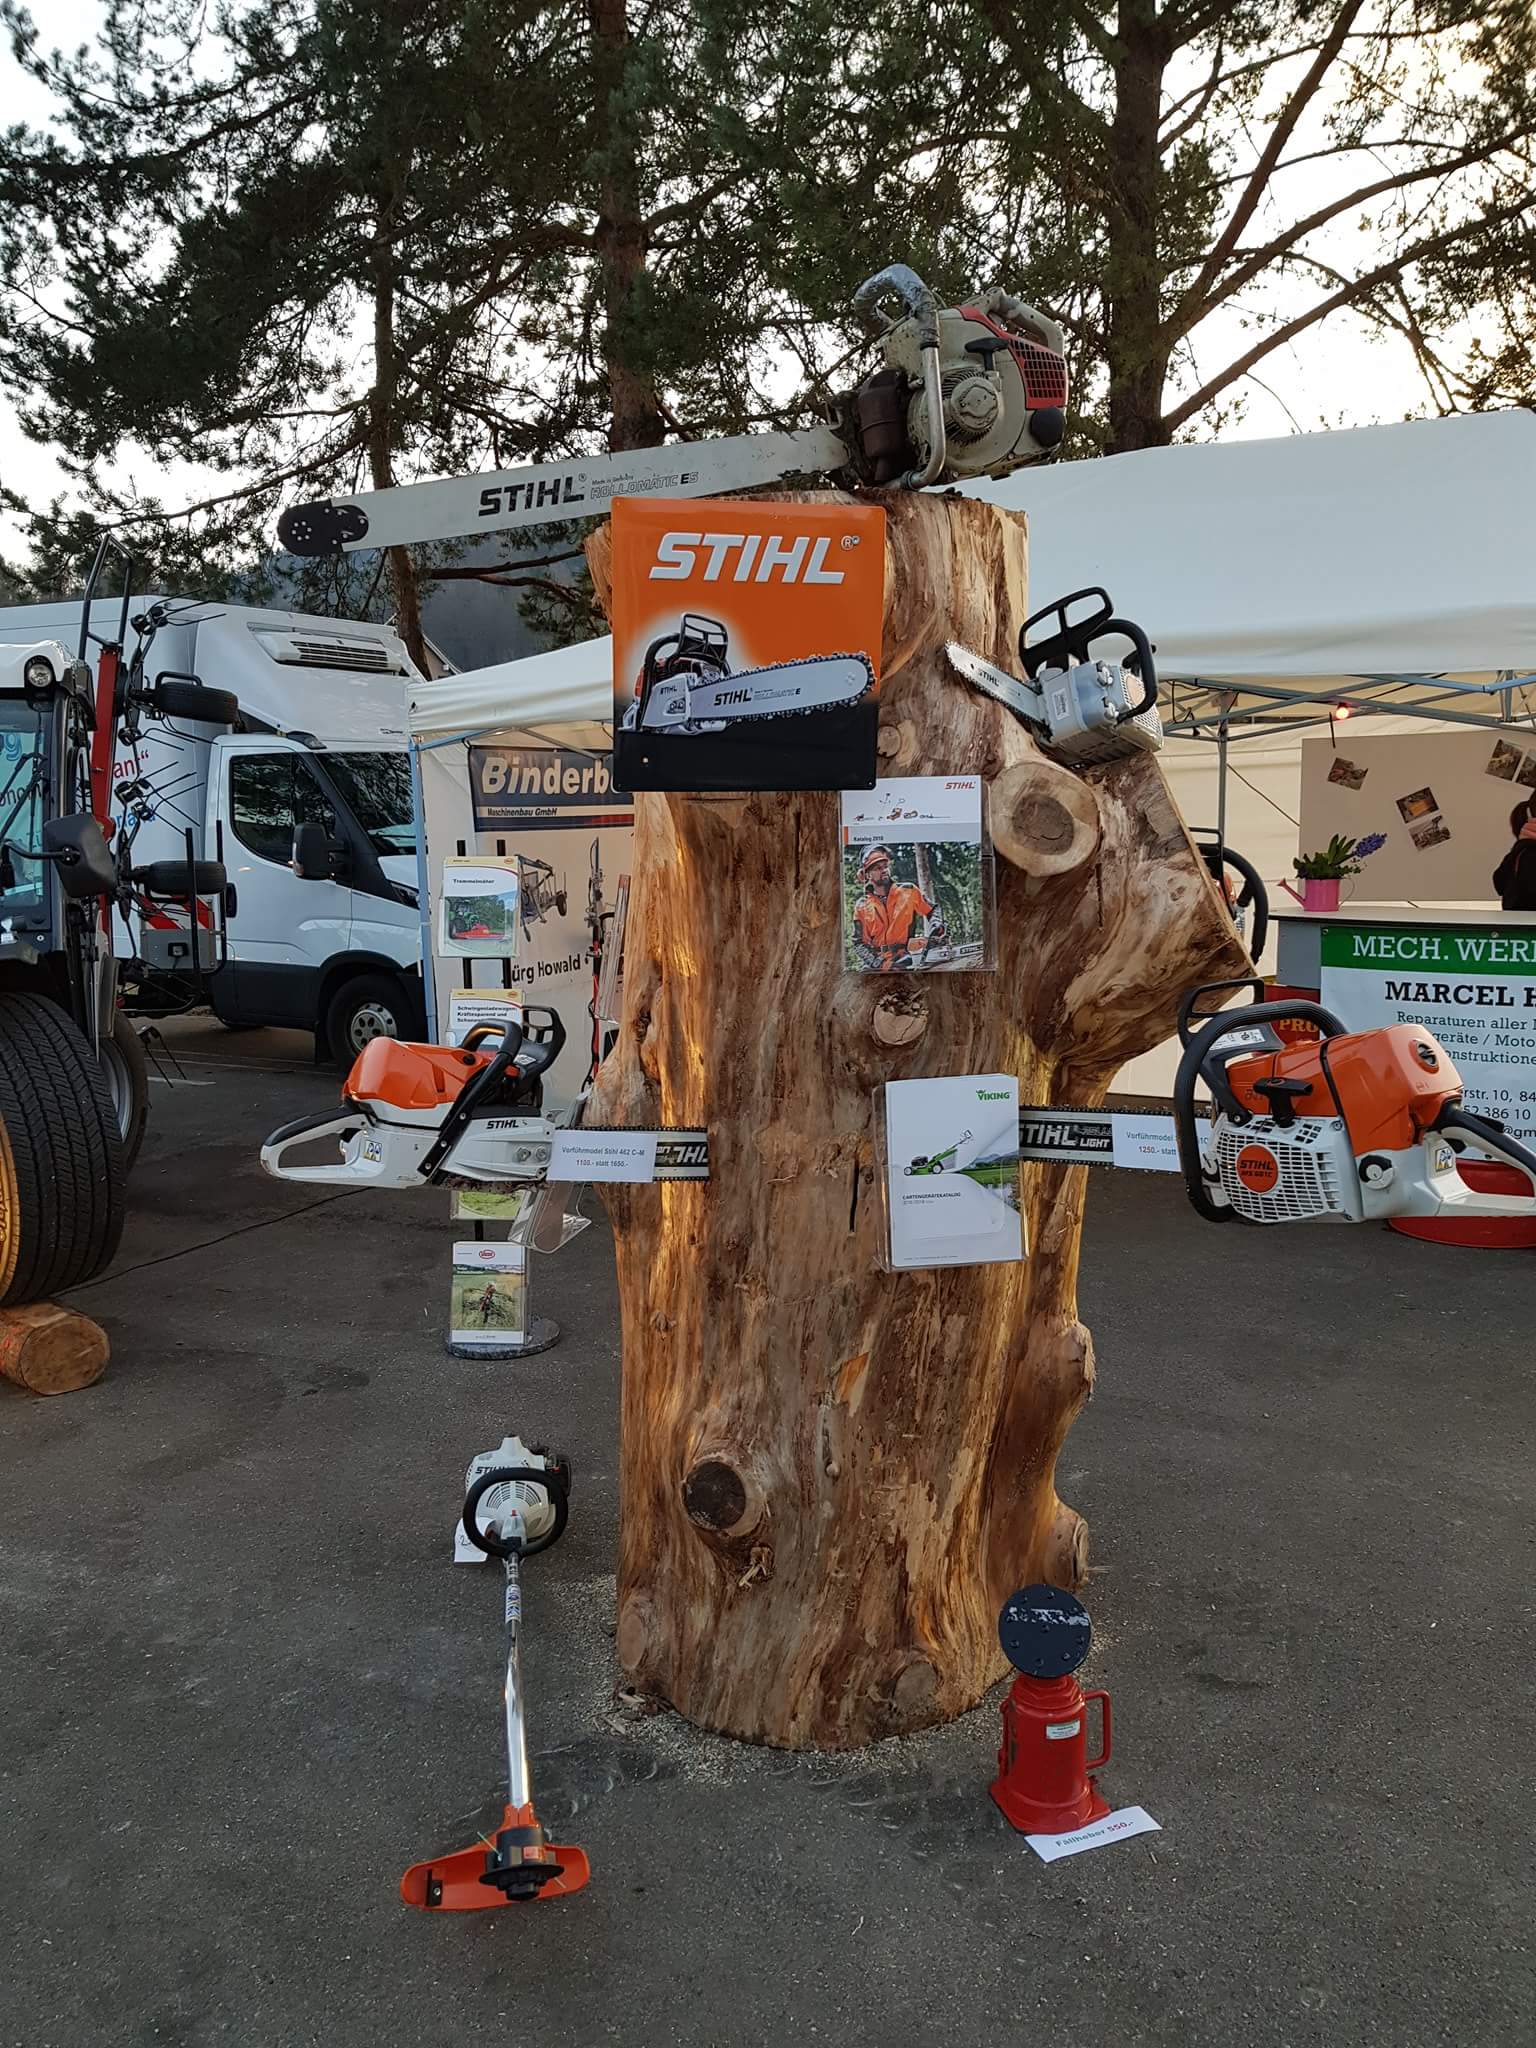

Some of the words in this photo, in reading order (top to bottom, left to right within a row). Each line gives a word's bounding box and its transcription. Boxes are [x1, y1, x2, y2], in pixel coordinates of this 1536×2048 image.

[590, 475, 678, 499] ROLLOMATIC
[478, 477, 584, 517] STIHL
[648, 531, 846, 584] STIHL
[713, 689, 753, 706] STIHL
[481, 755, 614, 795] Binderb
[944, 781, 976, 790] STIHL
[487, 808, 533, 817] Maschinenbau
[534, 807, 558, 816] GmbH
[1352, 935, 1449, 960] MECH.
[512, 964, 535, 984] ürg
[537, 953, 581, 977] Howald
[1385, 981, 1514, 1007] MARCEL
[1397, 1011, 1486, 1028] Reparaturen
[1493, 1018, 1527, 1030] aller
[977, 1091, 1010, 1101] VIKING
[1461, 1088, 1489, 1100] rstr.
[1493, 1089, 1513, 1103] 10,
[1515, 1109, 1531, 1120] 10
[486, 1119, 519, 1130] STIHL
[1079, 1137, 1110, 1148] LIGHT
[1239, 1159, 1274, 1170] STIHL
